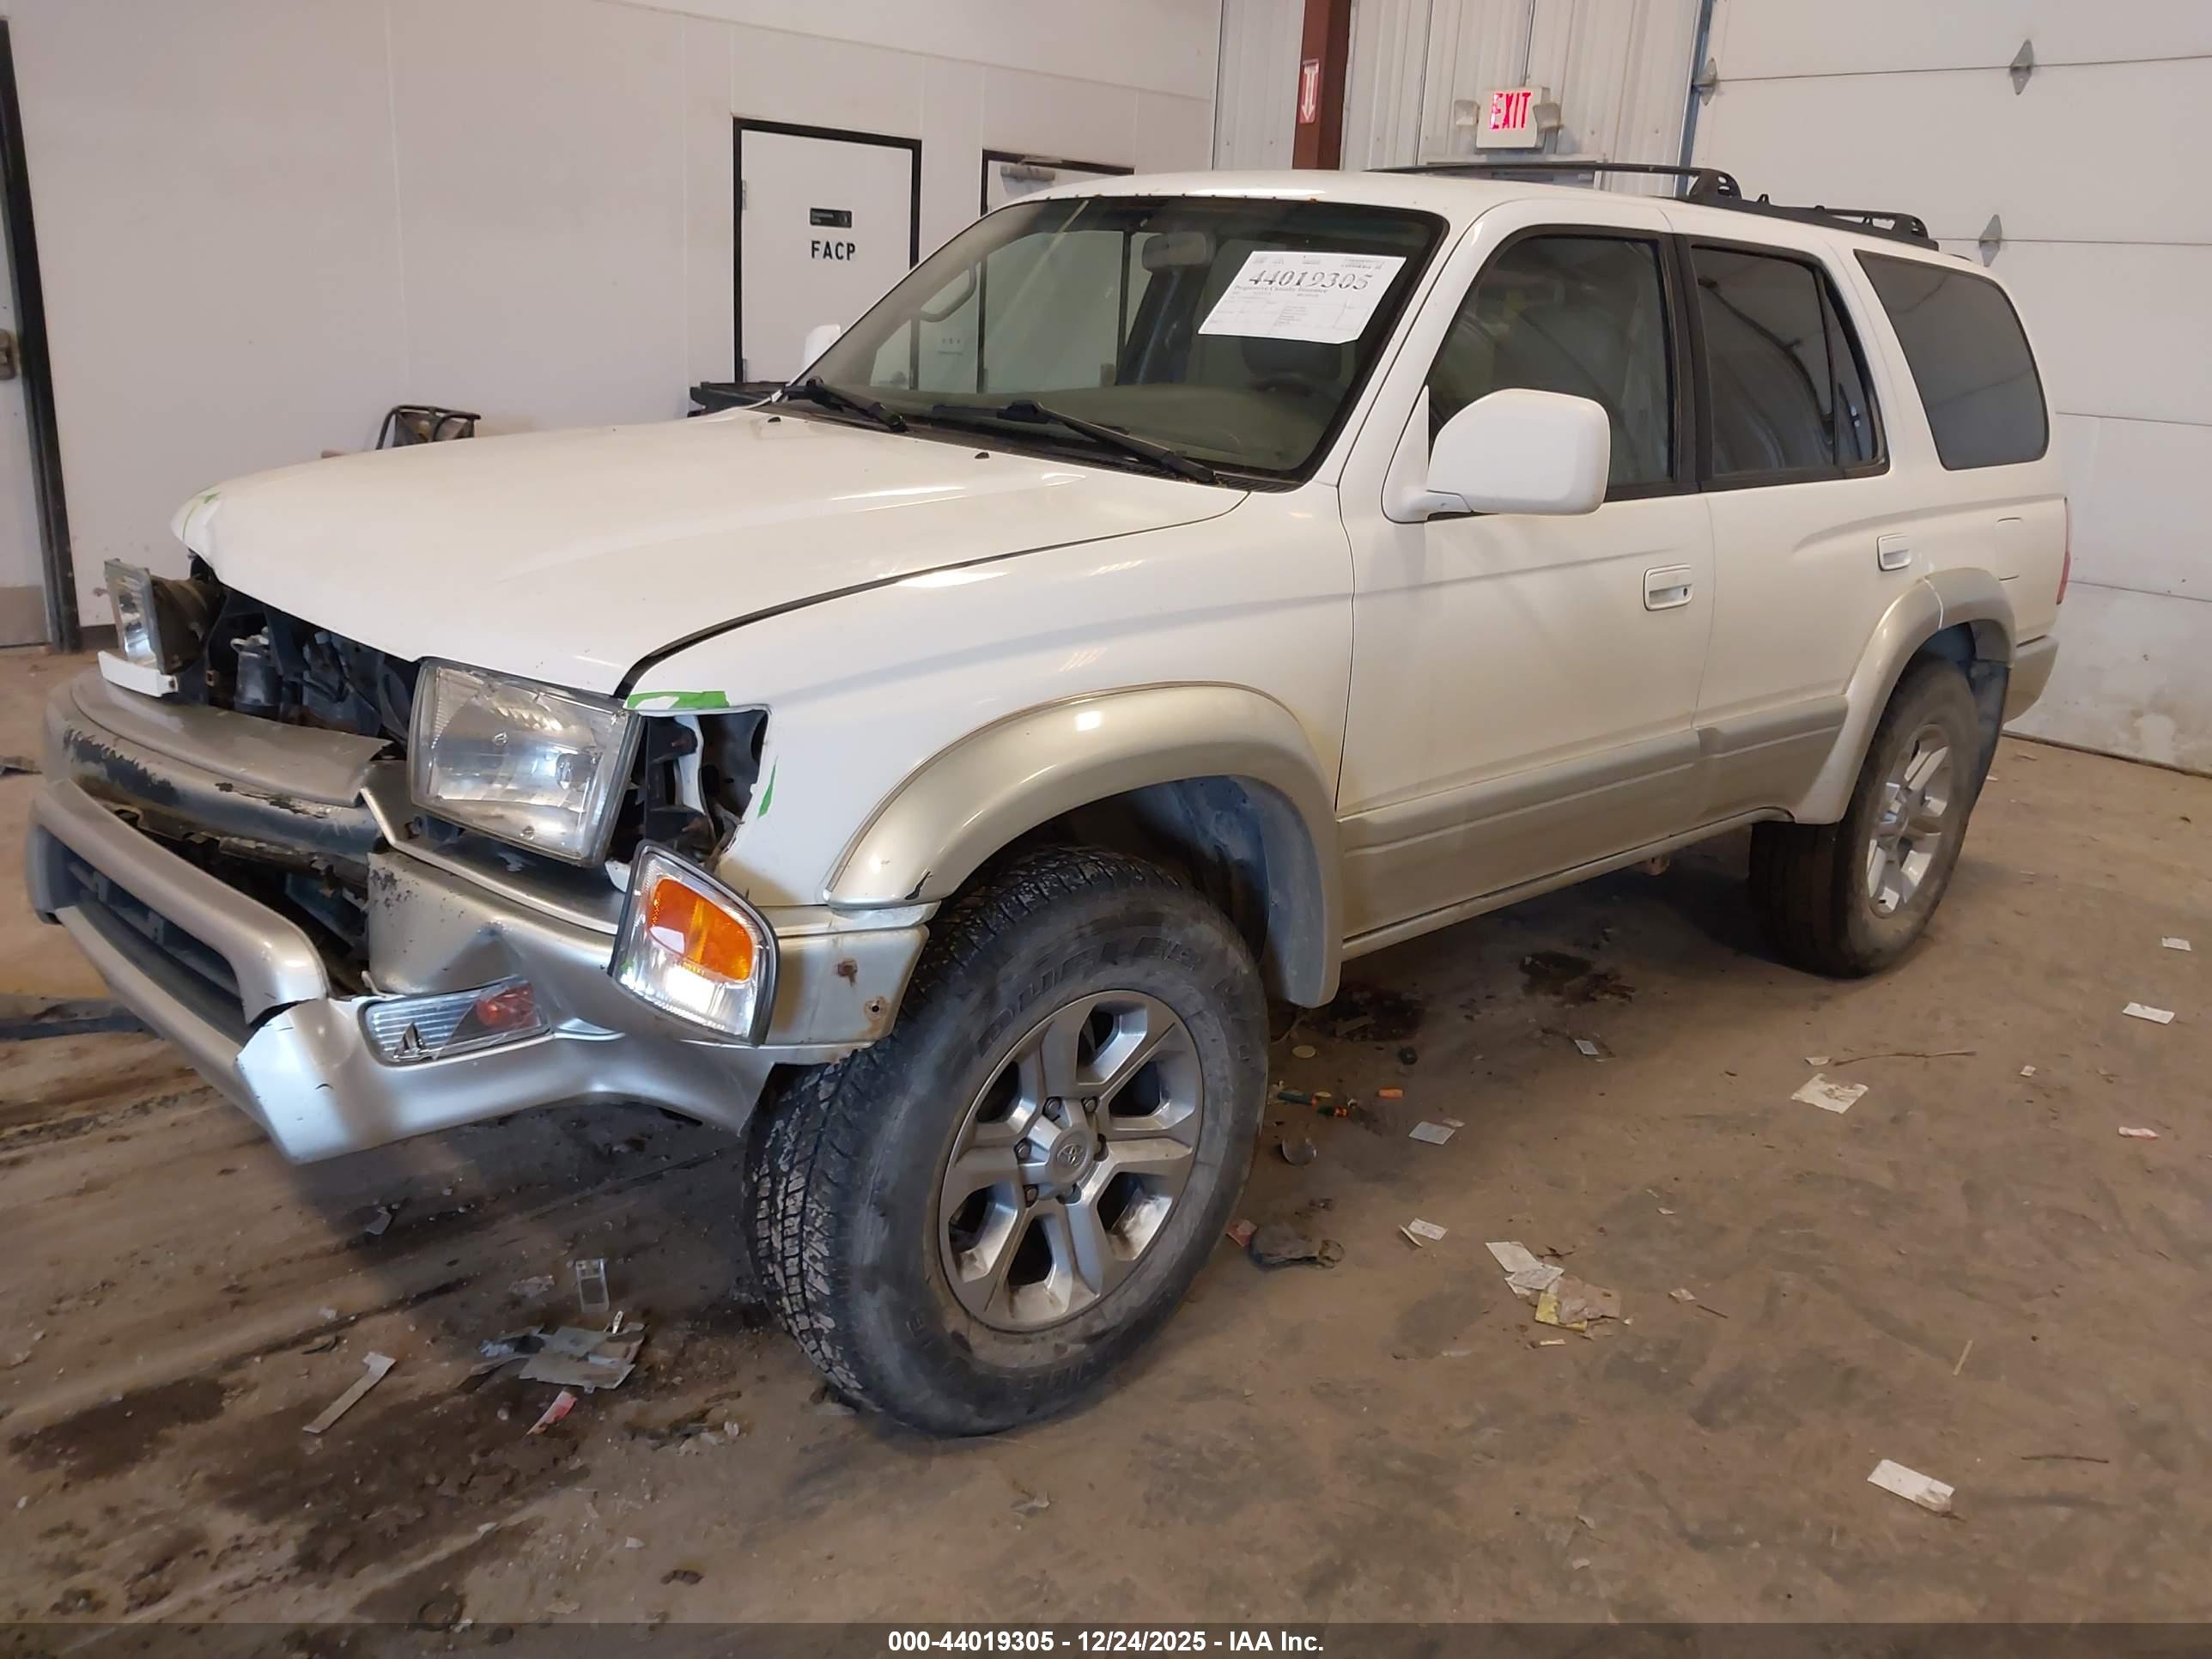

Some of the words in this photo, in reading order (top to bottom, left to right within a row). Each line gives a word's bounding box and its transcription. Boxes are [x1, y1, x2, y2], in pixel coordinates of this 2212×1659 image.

[1489, 92, 1531, 130] EXIT
[811, 240, 855, 261] FACP
[1249, 270, 1373, 290] 44019305
